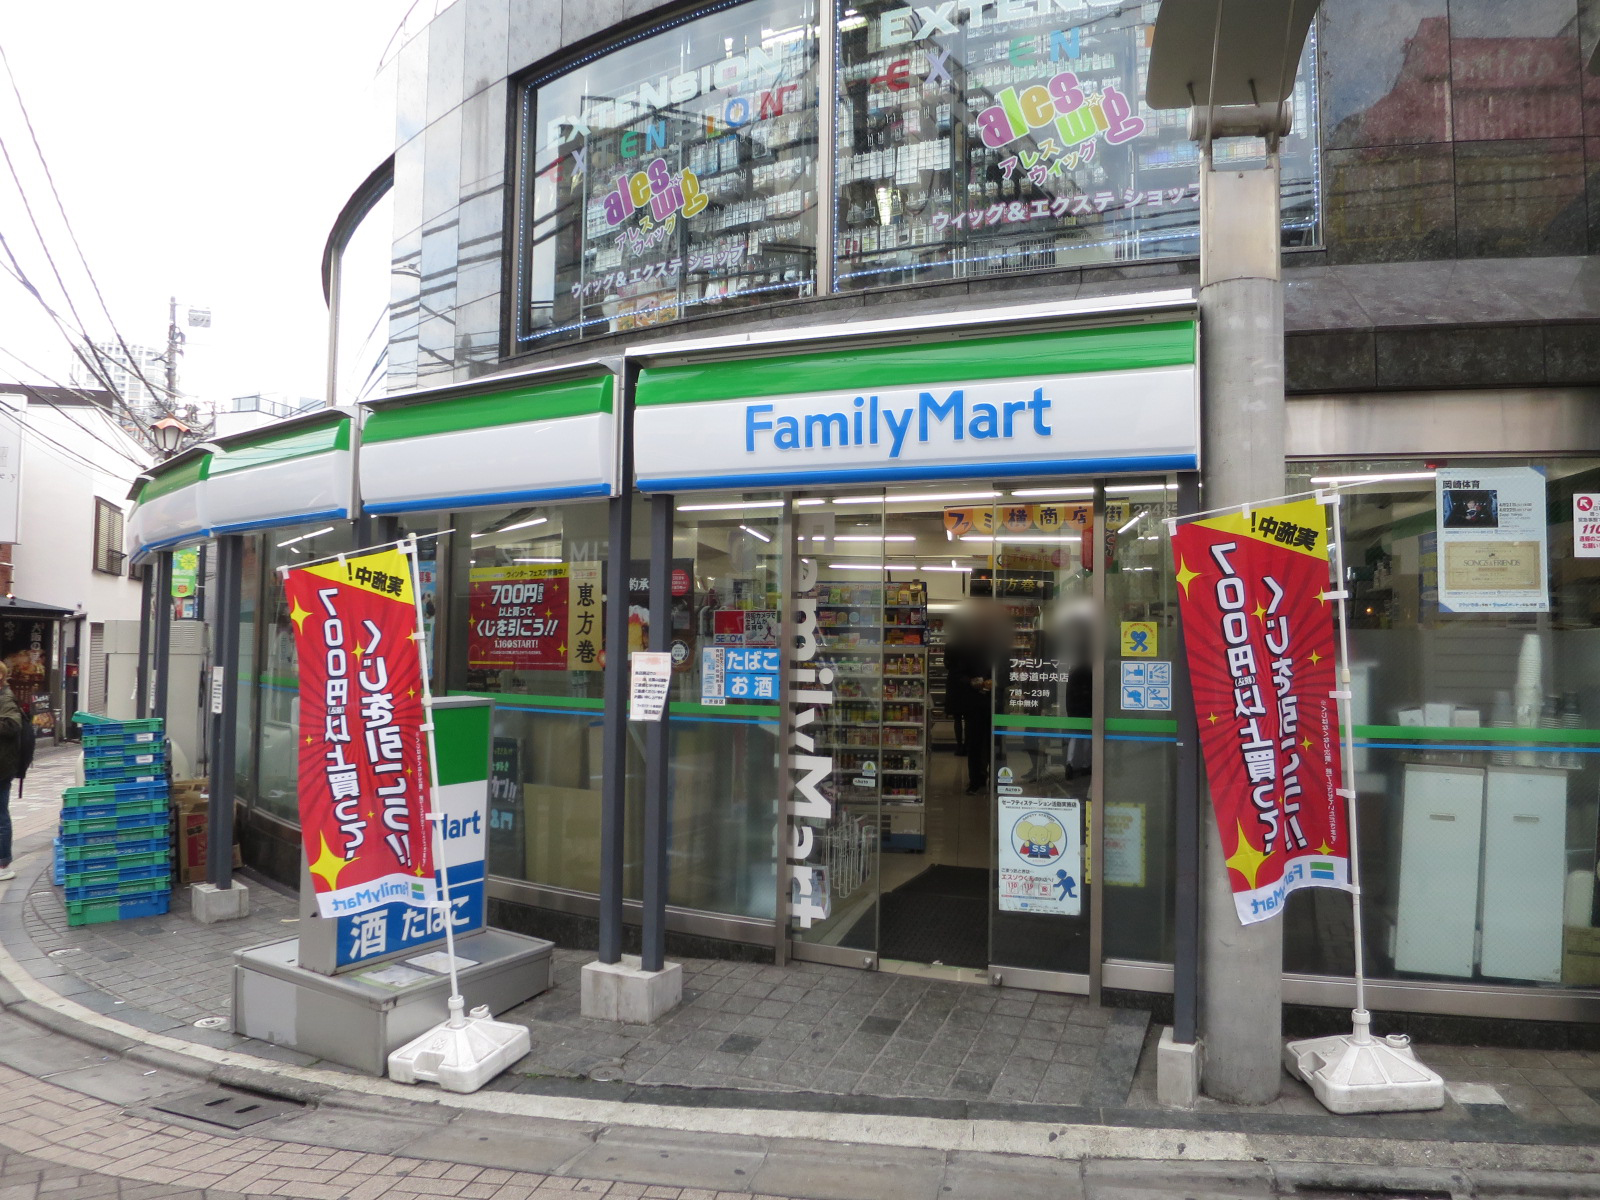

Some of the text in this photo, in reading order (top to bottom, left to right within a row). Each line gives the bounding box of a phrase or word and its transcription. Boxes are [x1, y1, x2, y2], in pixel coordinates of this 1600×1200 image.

[976, 72, 1084, 148] ales
[998, 138, 1060, 180] アレス
[603, 157, 671, 226] ales
[745, 386, 1053, 459] FamilyMart
[491, 583, 538, 605] 700円
[575, 582, 597, 664] 恵方巻
[727, 650, 778, 671] たばこ
[1009, 658, 1070, 669] ファミリーマー
[731, 676, 773, 698] お酒
[1009, 672, 1069, 683] 表参道中央店
[1009, 699, 1039, 708] 年中無休
[1031, 844, 1047, 853] SS
[349, 908, 388, 959] 酒
